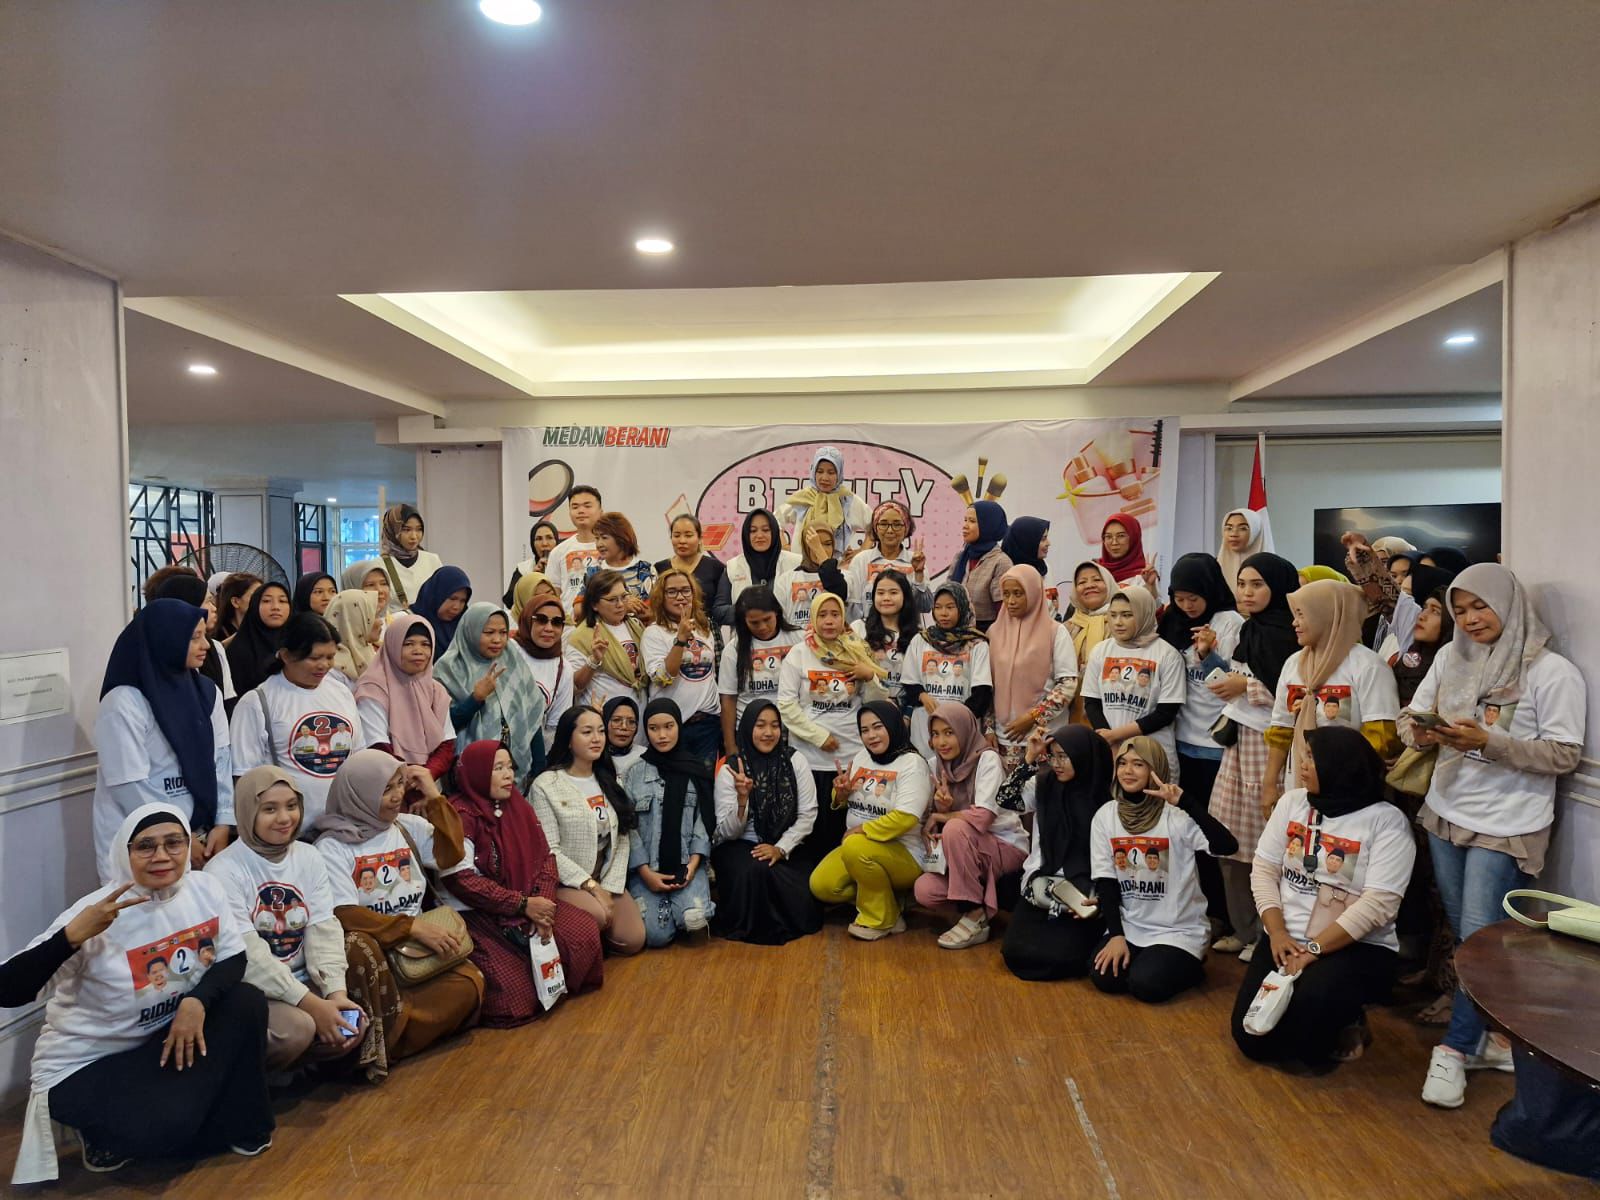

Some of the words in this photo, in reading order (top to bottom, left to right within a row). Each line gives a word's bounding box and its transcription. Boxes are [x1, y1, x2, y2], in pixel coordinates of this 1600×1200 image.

[736, 468, 934, 517] BETY
[891, 649, 898, 660] 2
[768, 656, 776, 669] 2
[942, 661, 949, 674] 2
[1123, 666, 1133, 681] 2
[833, 679, 840, 692] 2
[314, 715, 332, 736] 2
[865, 778, 875, 792] 2
[595, 806, 605, 820] 2
[382, 865, 393, 884] 2
[270, 887, 286, 912] 2
[176, 948, 190, 974] 2
